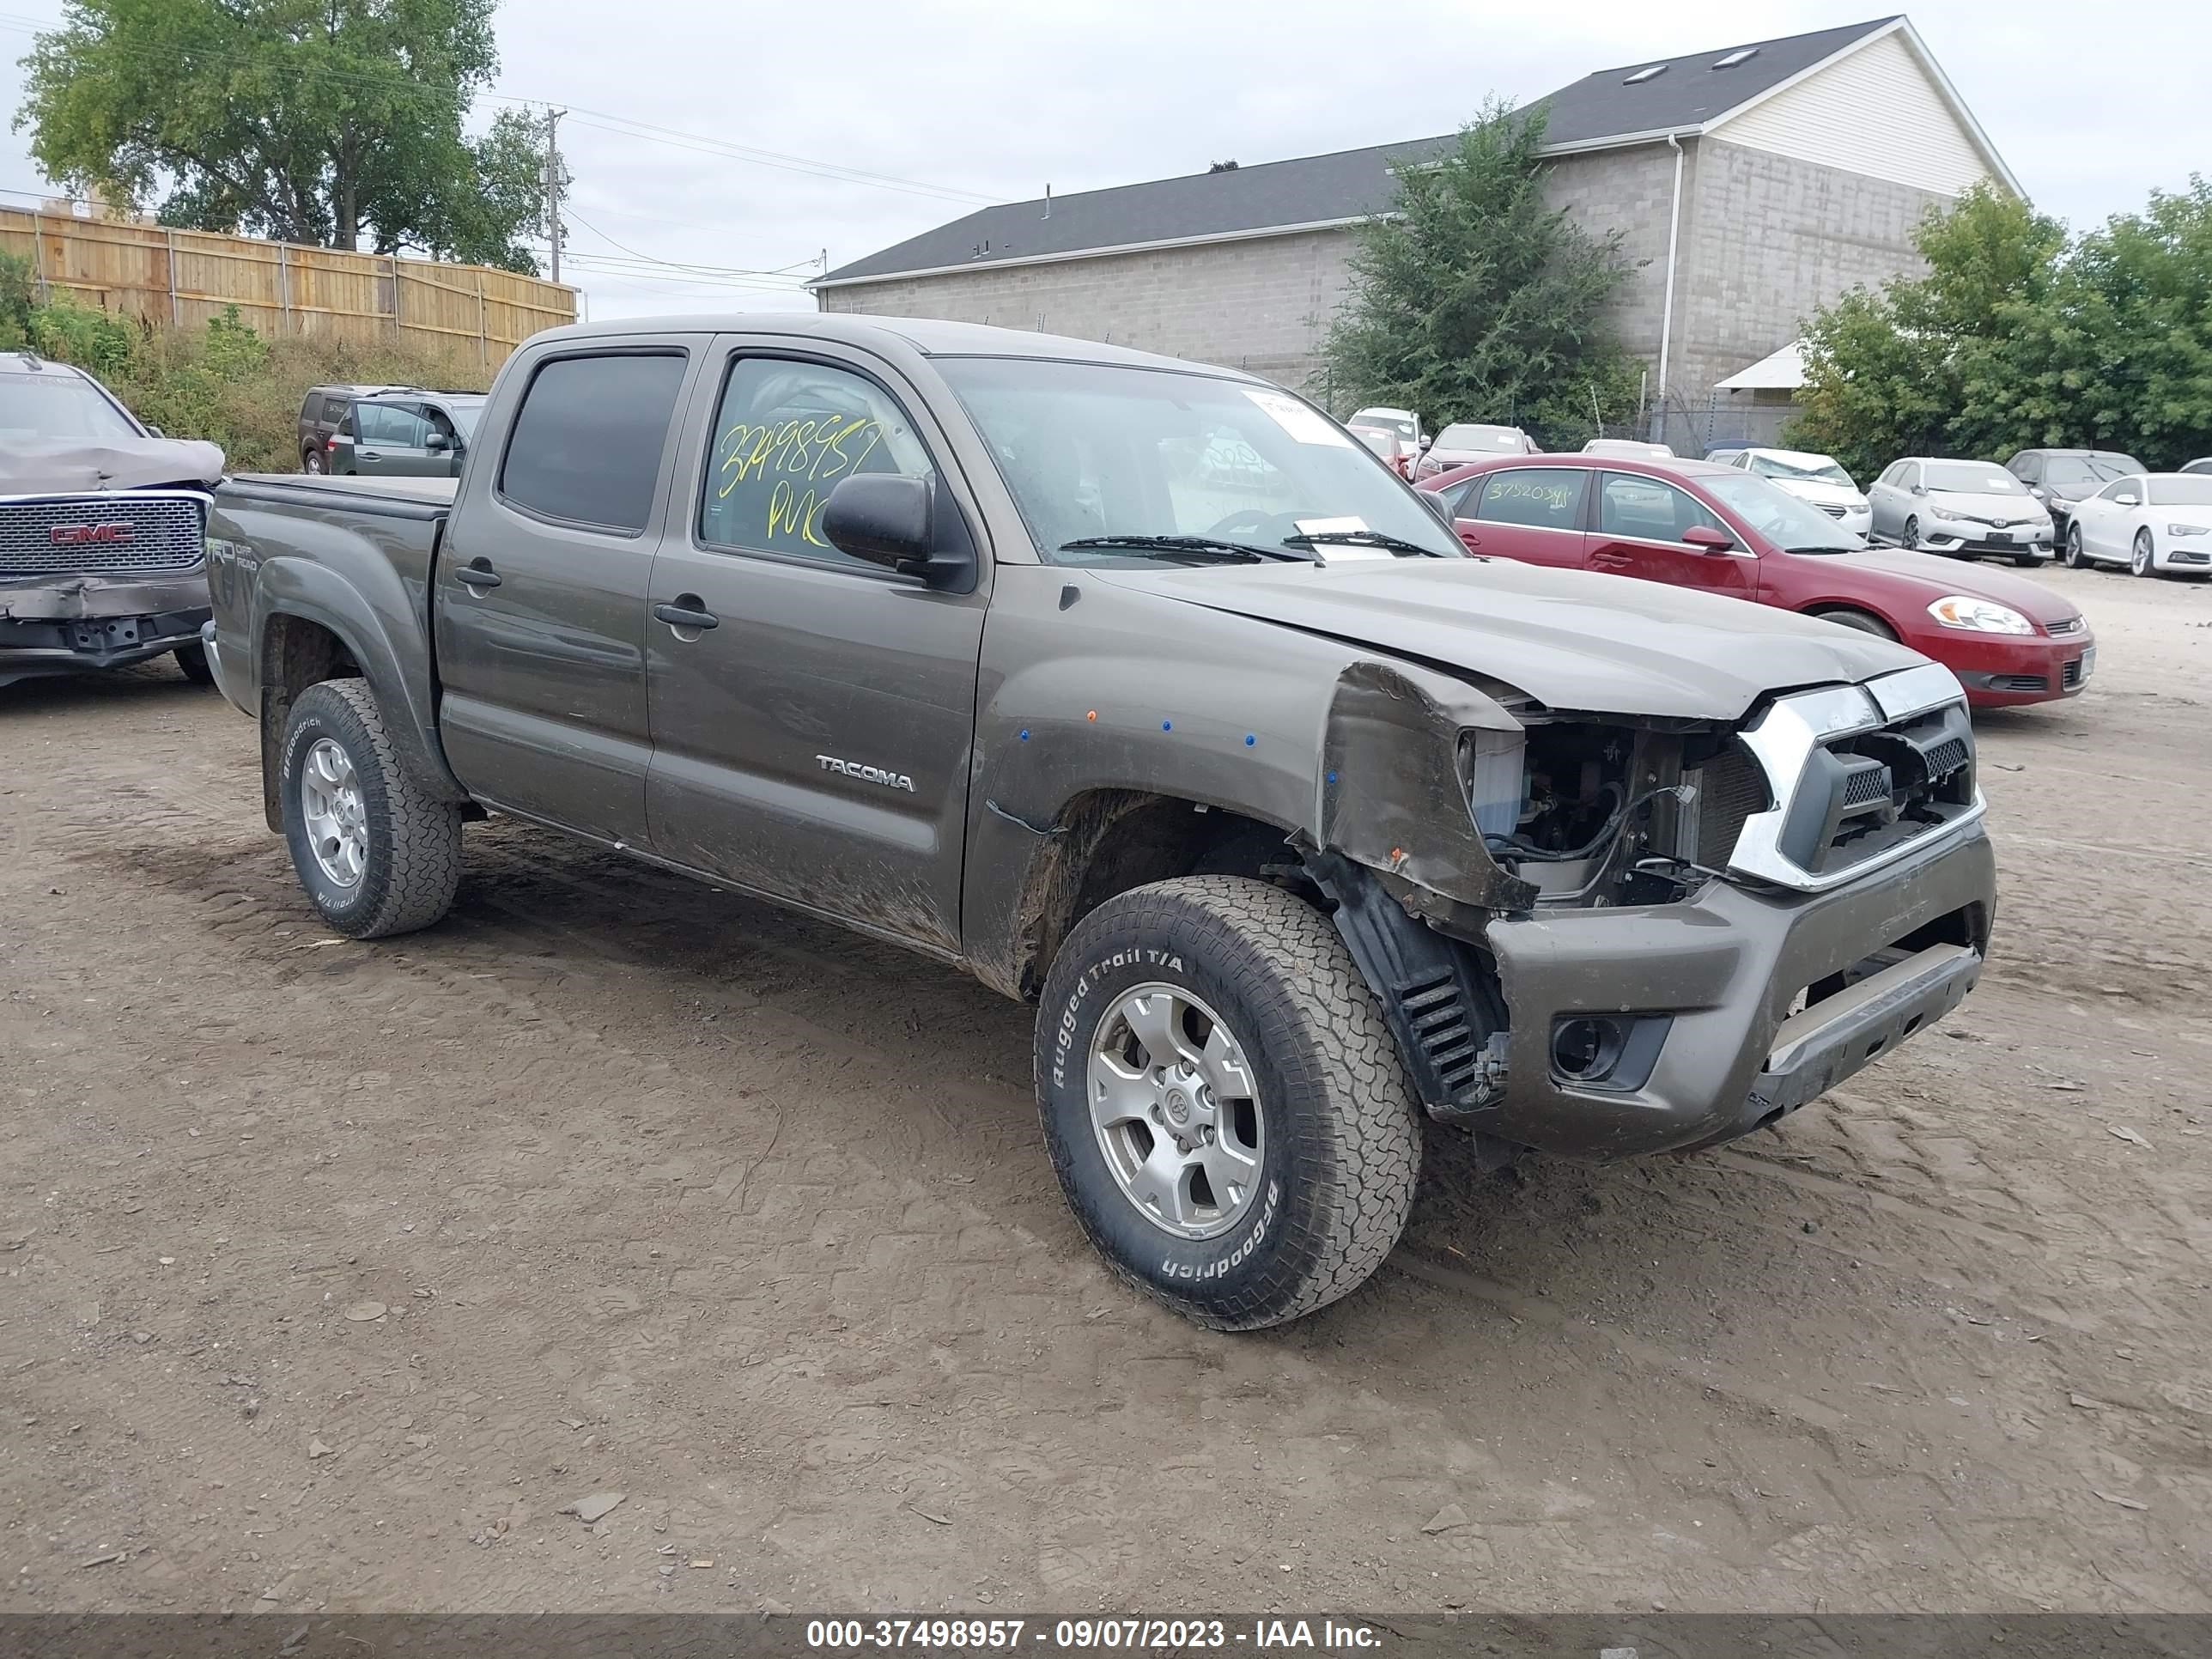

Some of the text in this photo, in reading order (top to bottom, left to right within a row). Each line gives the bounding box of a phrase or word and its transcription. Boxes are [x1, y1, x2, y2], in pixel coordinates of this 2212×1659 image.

[51, 522, 136, 544] GMC
[204, 537, 235, 564] TRD
[235, 544, 252, 556] OFF
[236, 556, 258, 571] ROAD
[283, 717, 321, 780] BFGoodrich
[815, 754, 917, 793] TACOMA
[1053, 948, 1183, 1090] Rugged Trail T/A
[1162, 1179, 1279, 1282] BFGoodrich
